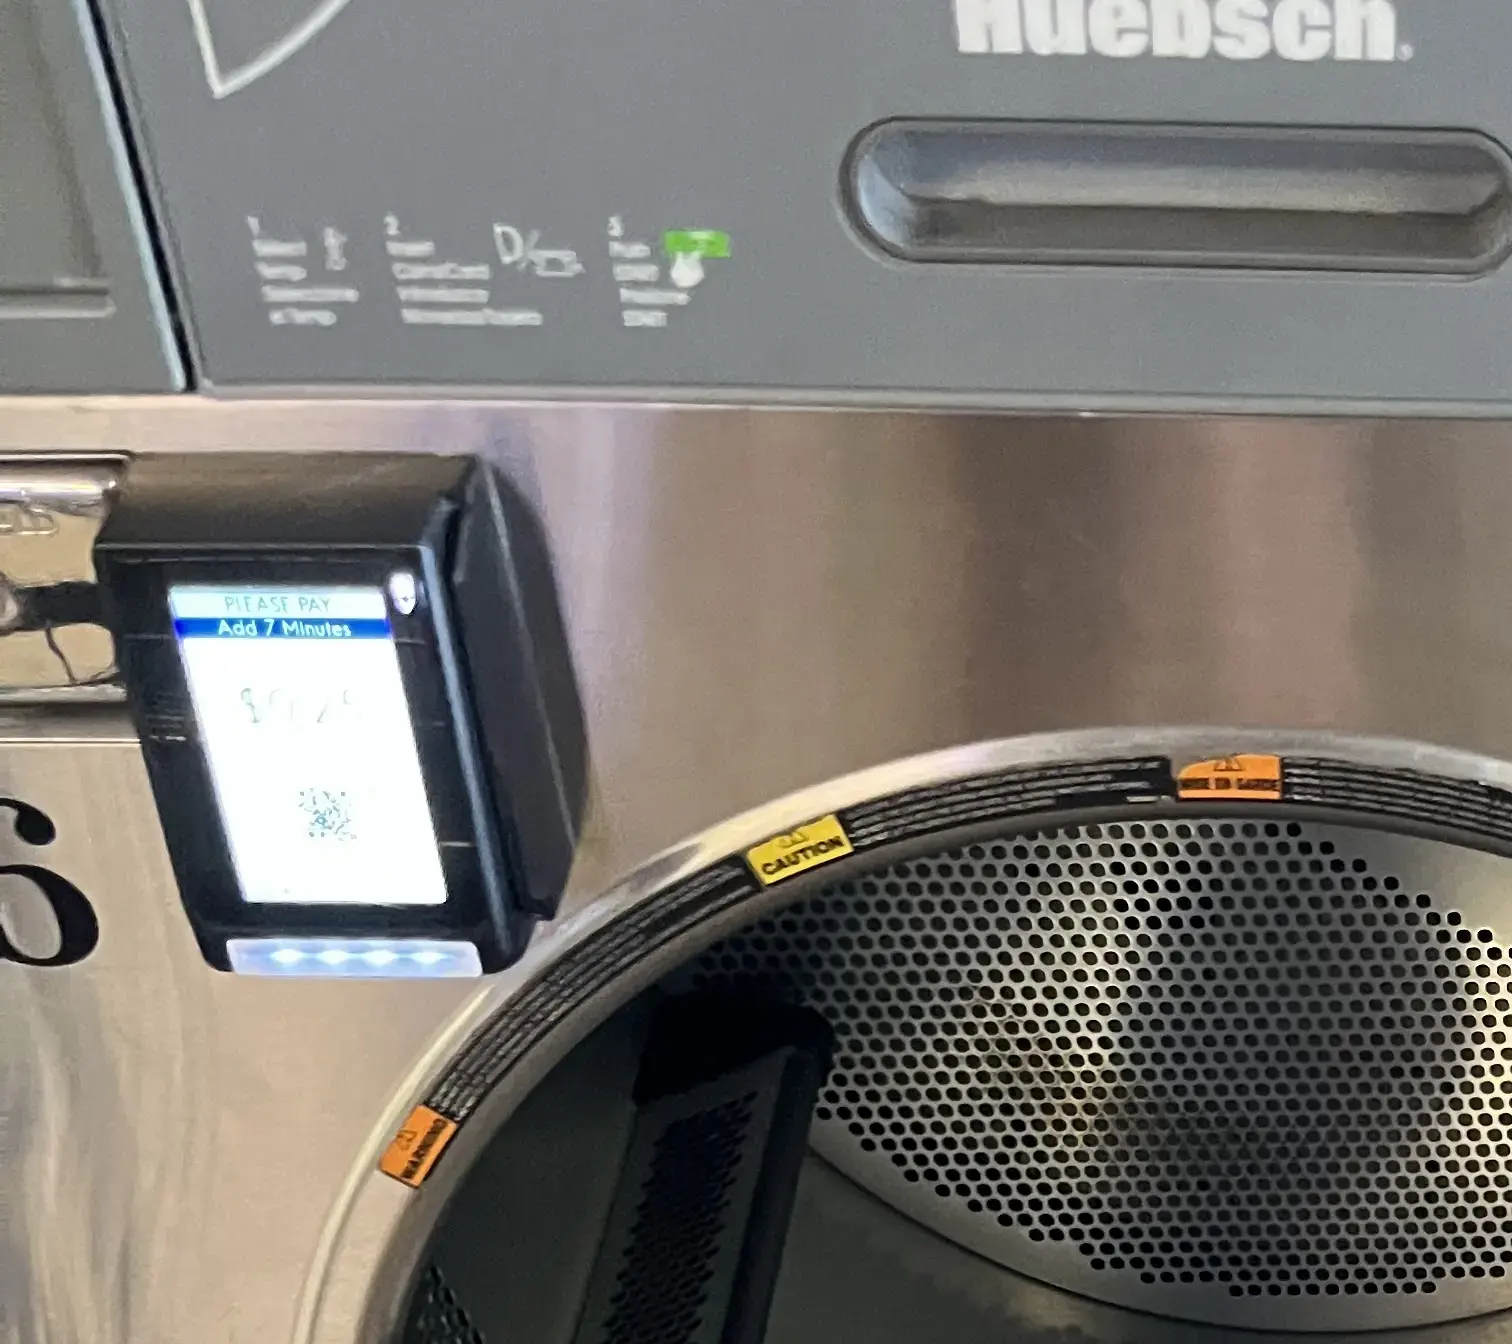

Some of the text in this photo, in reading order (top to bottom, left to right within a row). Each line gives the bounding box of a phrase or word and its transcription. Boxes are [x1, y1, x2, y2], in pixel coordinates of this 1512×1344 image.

[225, 596, 331, 613] PLEASE PAY
[218, 618, 352, 638] Add 7 Minutes
[761, 835, 844, 875] CAUTION
